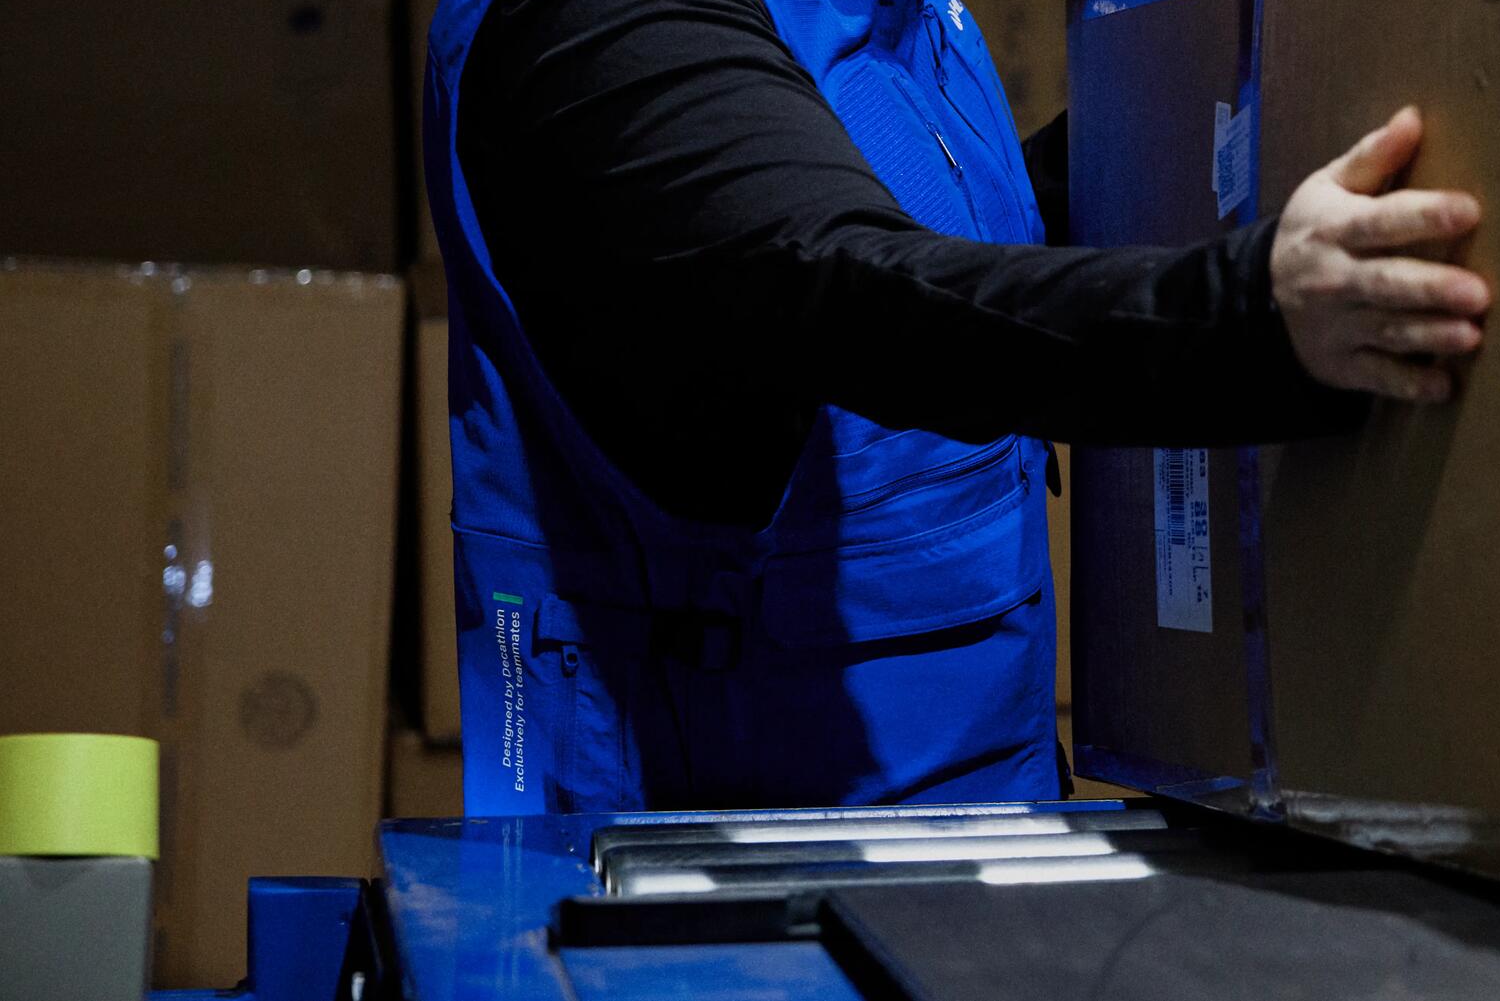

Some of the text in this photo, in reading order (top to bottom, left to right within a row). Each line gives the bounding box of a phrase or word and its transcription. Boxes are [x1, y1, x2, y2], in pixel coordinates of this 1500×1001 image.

[495, 608, 514, 768] Designed by Decathlon
[510, 611, 526, 792] Exclusively for teammates
